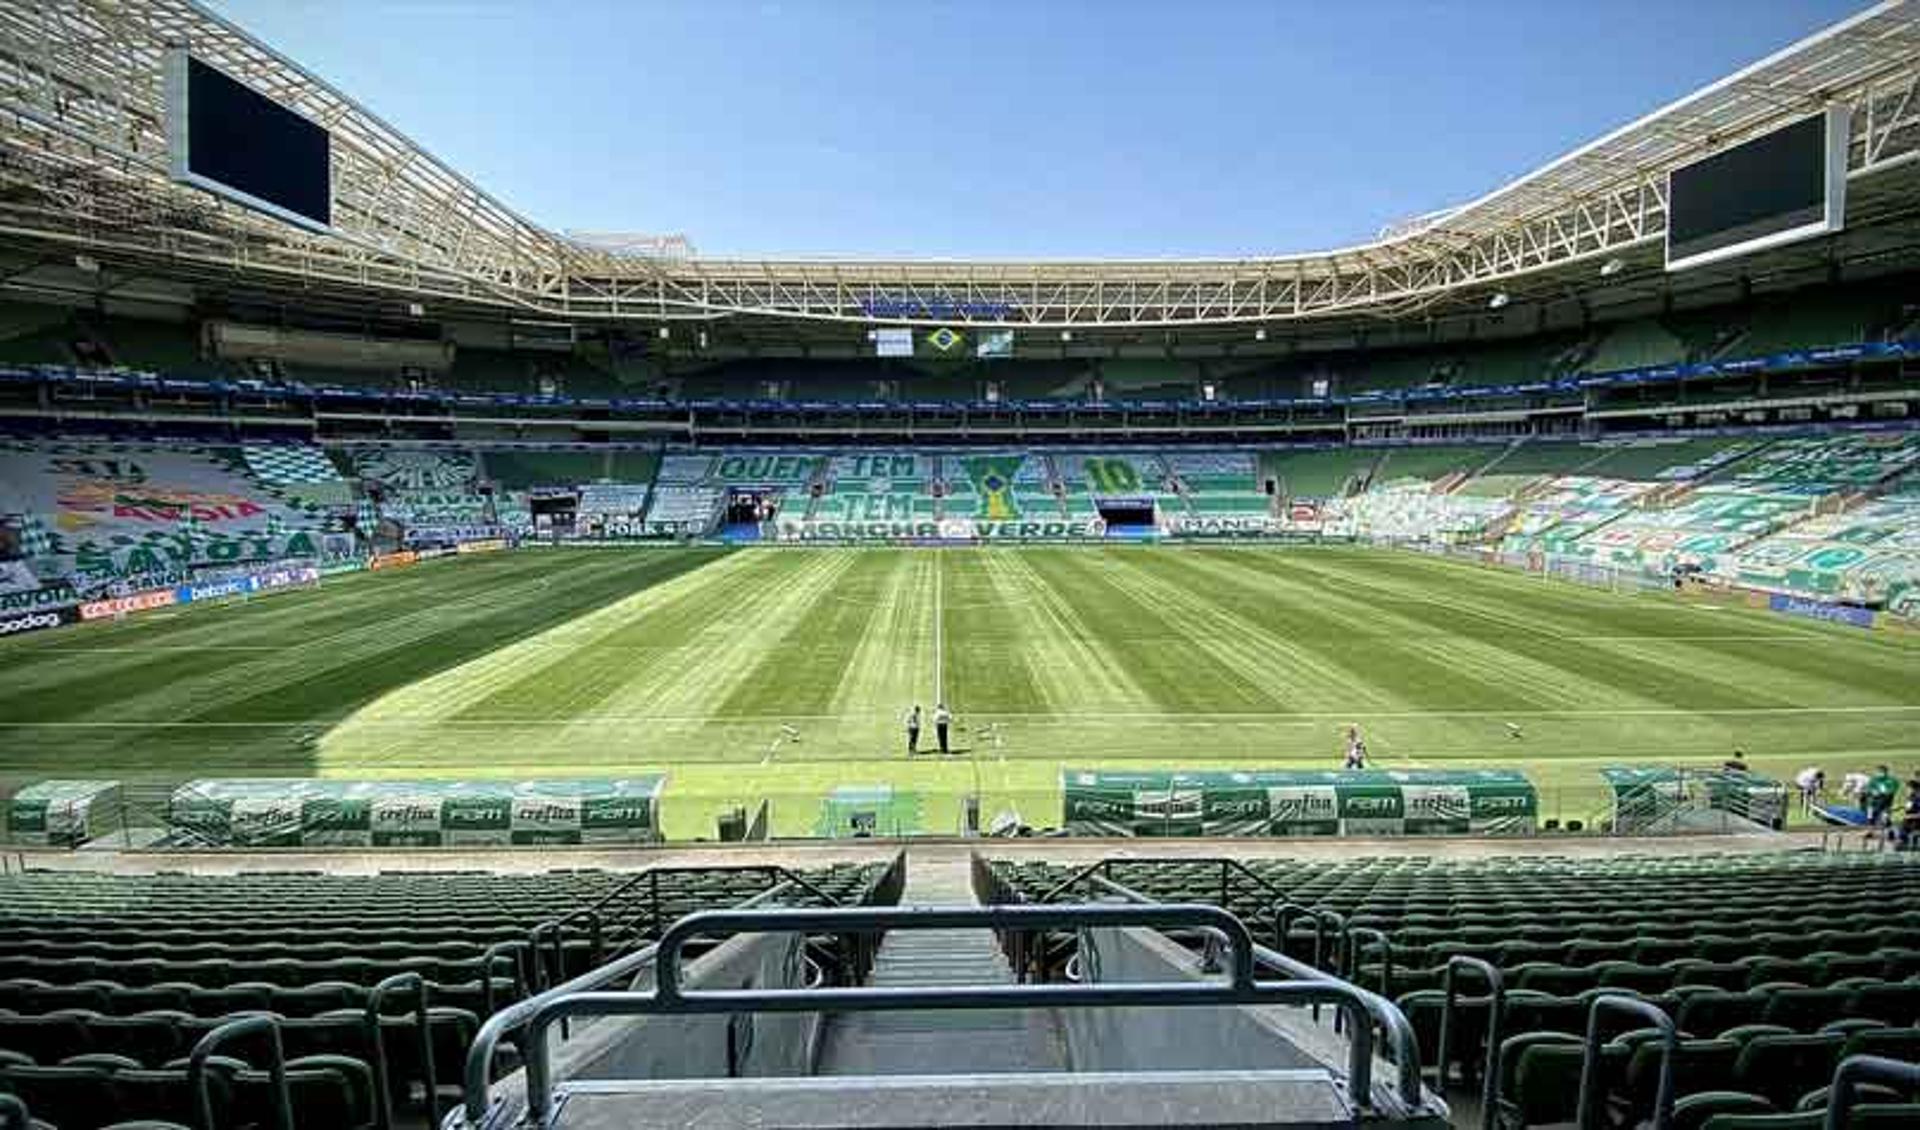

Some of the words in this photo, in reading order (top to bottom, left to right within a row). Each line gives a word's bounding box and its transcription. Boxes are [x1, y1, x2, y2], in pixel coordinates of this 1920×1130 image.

[719, 455, 824, 479] QUEM
[853, 455, 915, 477] TEM
[1083, 457, 1140, 494] 10
[843, 495, 914, 520] TEM
[975, 522, 1086, 537] VERDE
